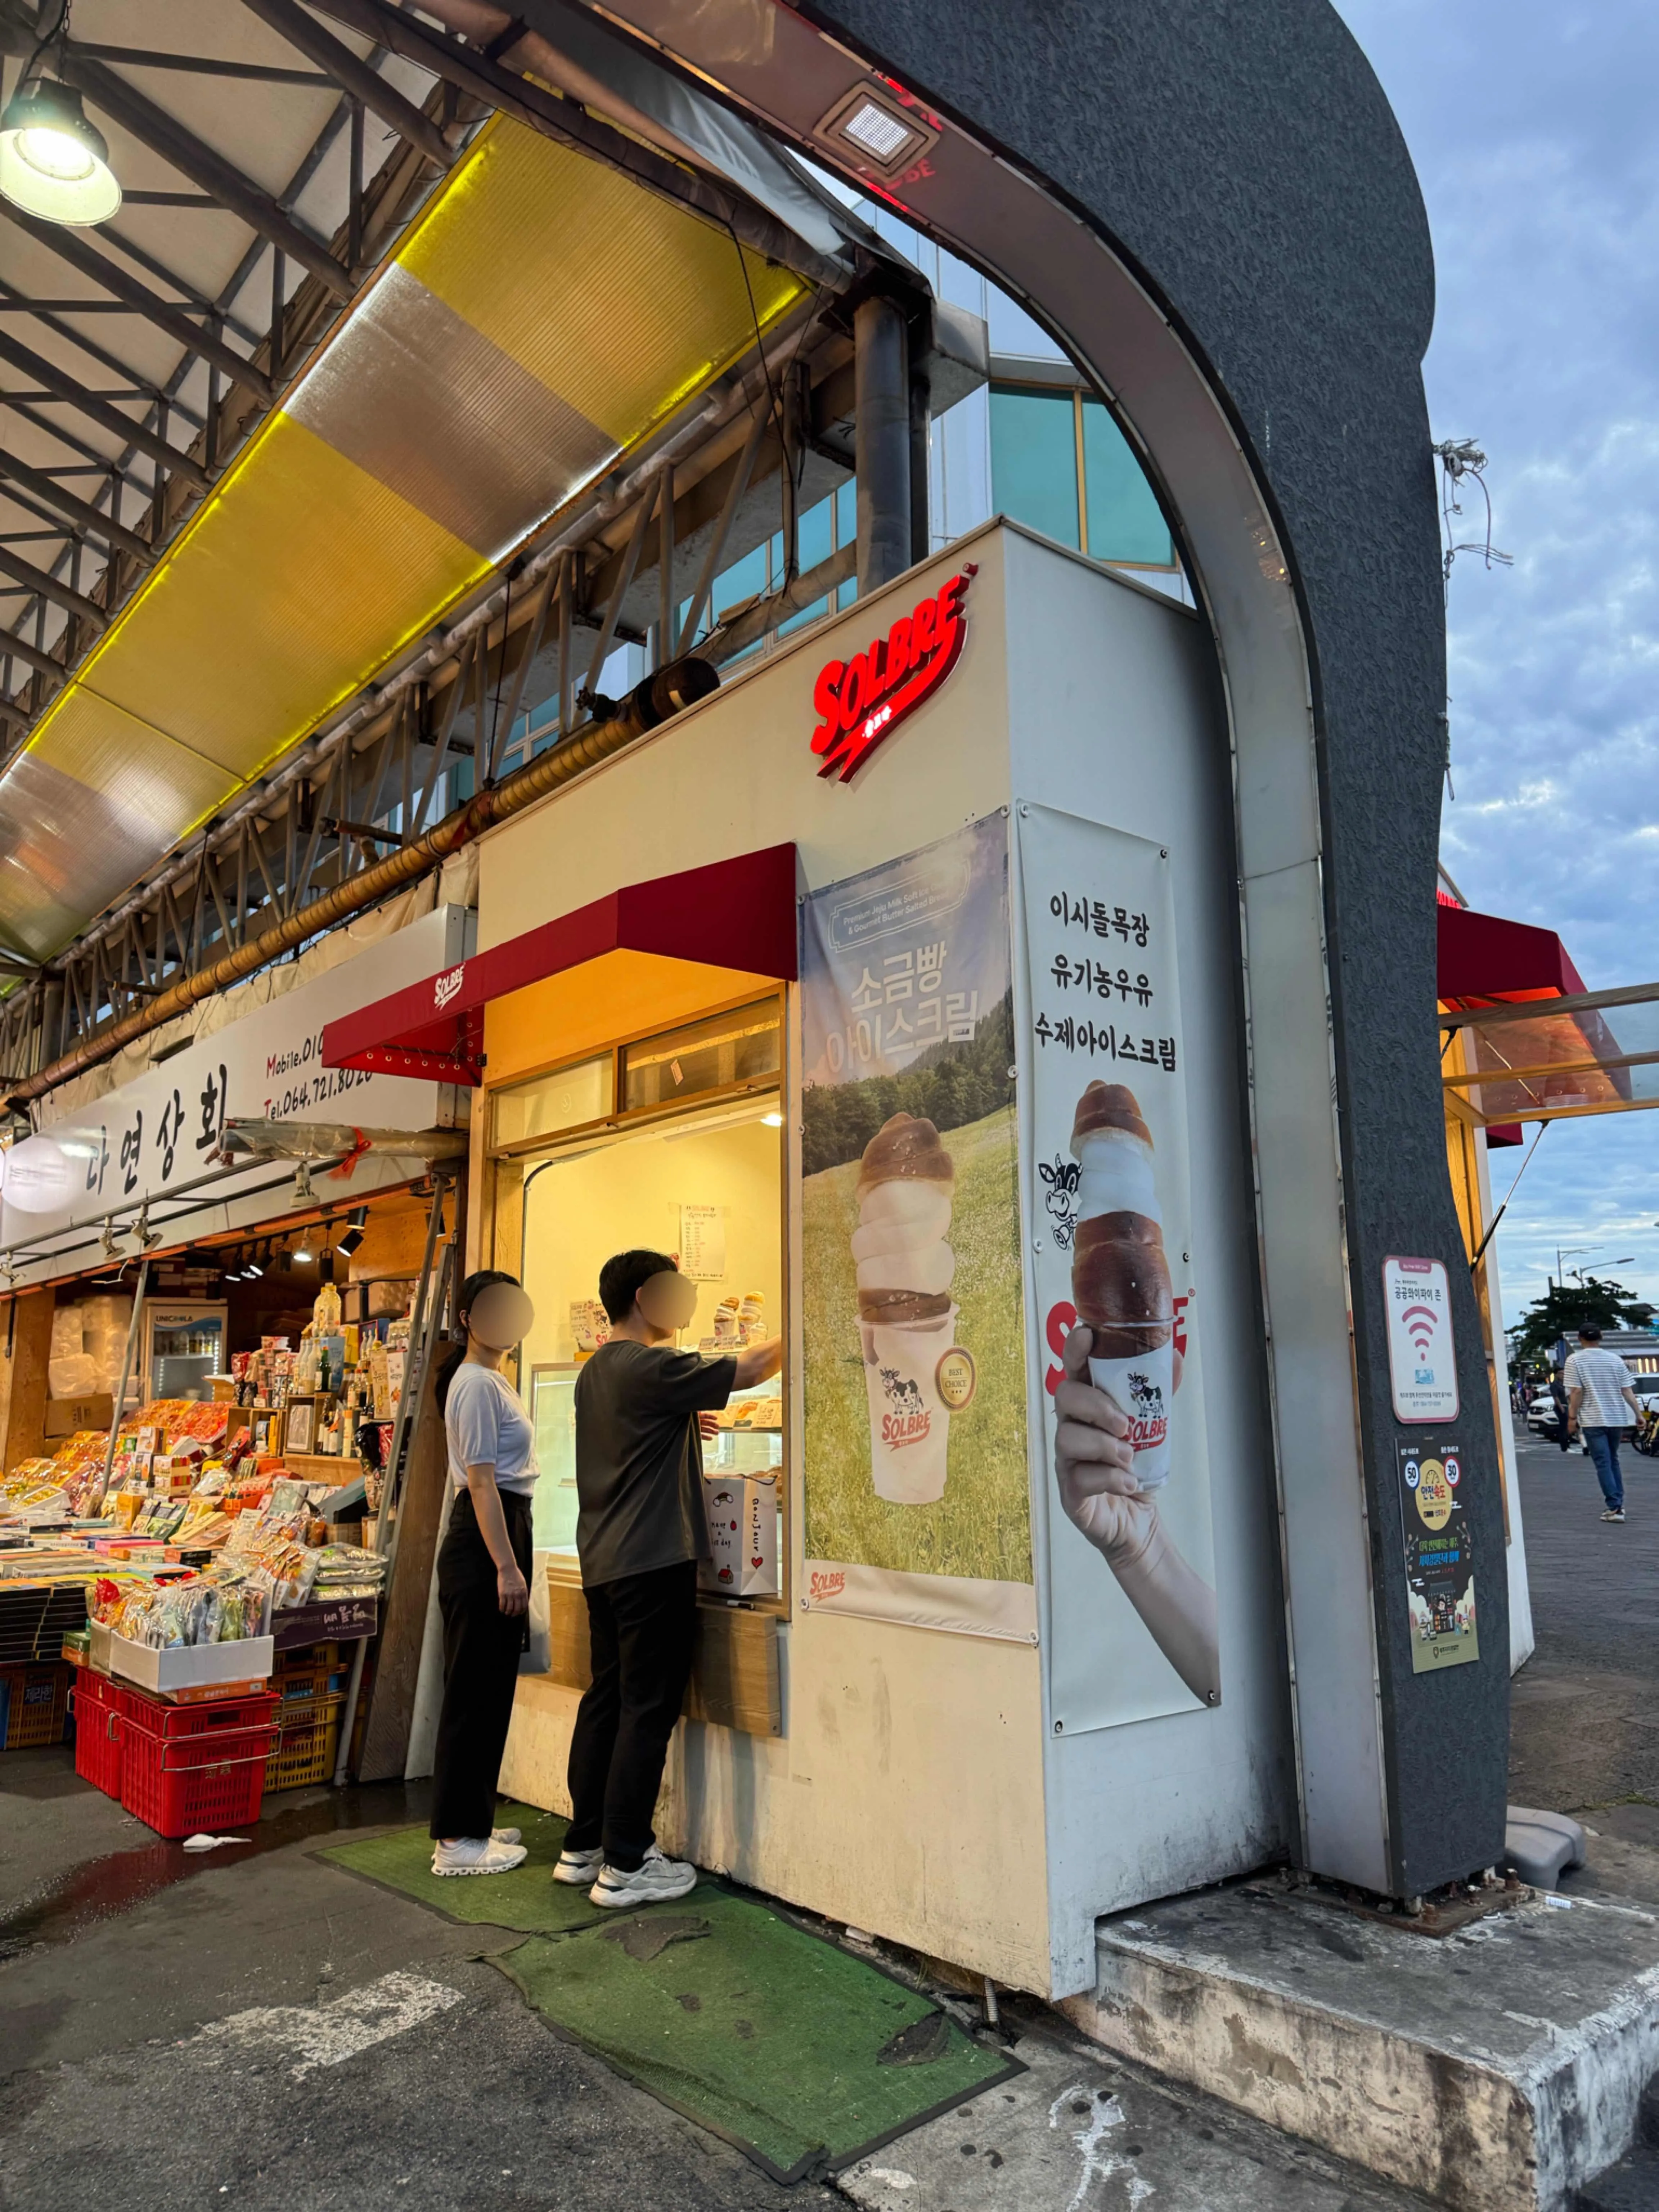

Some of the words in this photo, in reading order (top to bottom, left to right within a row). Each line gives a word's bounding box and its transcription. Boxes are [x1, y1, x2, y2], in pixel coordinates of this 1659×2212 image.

[810, 574, 970, 755] SOLBRE
[843, 910, 871, 926] Premium
[871, 905, 886, 916] Jeju
[887, 898, 902, 909] Milk
[903, 893, 918, 903] Soft
[918, 887, 930, 896] Ice
[854, 916, 881, 933] Gourmet
[882, 909, 904, 922] Butter
[905, 899, 927, 914] Salted
[1050, 891, 1150, 948] 이시돌목장
[851, 940, 947, 1013] 소금빵
[1051, 954, 1153, 1008] 유기농우유
[827, 990, 978, 1073] 아이스크림
[1034, 1012, 1175, 1072] 수제아이스크림
[1395, 1287, 1433, 1300] 공공와이파이
[1434, 1289, 1441, 1301] 존
[945, 1380, 967, 1388] CHOICE
[949, 1368, 963, 1376] BEST
[882, 1410, 932, 1440] SOLBRE
[1408, 1467, 1416, 1479] 50
[1447, 1464, 1456, 1476] 30
[1421, 1484, 1446, 1500] 안전속도
[810, 1572, 845, 1595] SOLBRE
